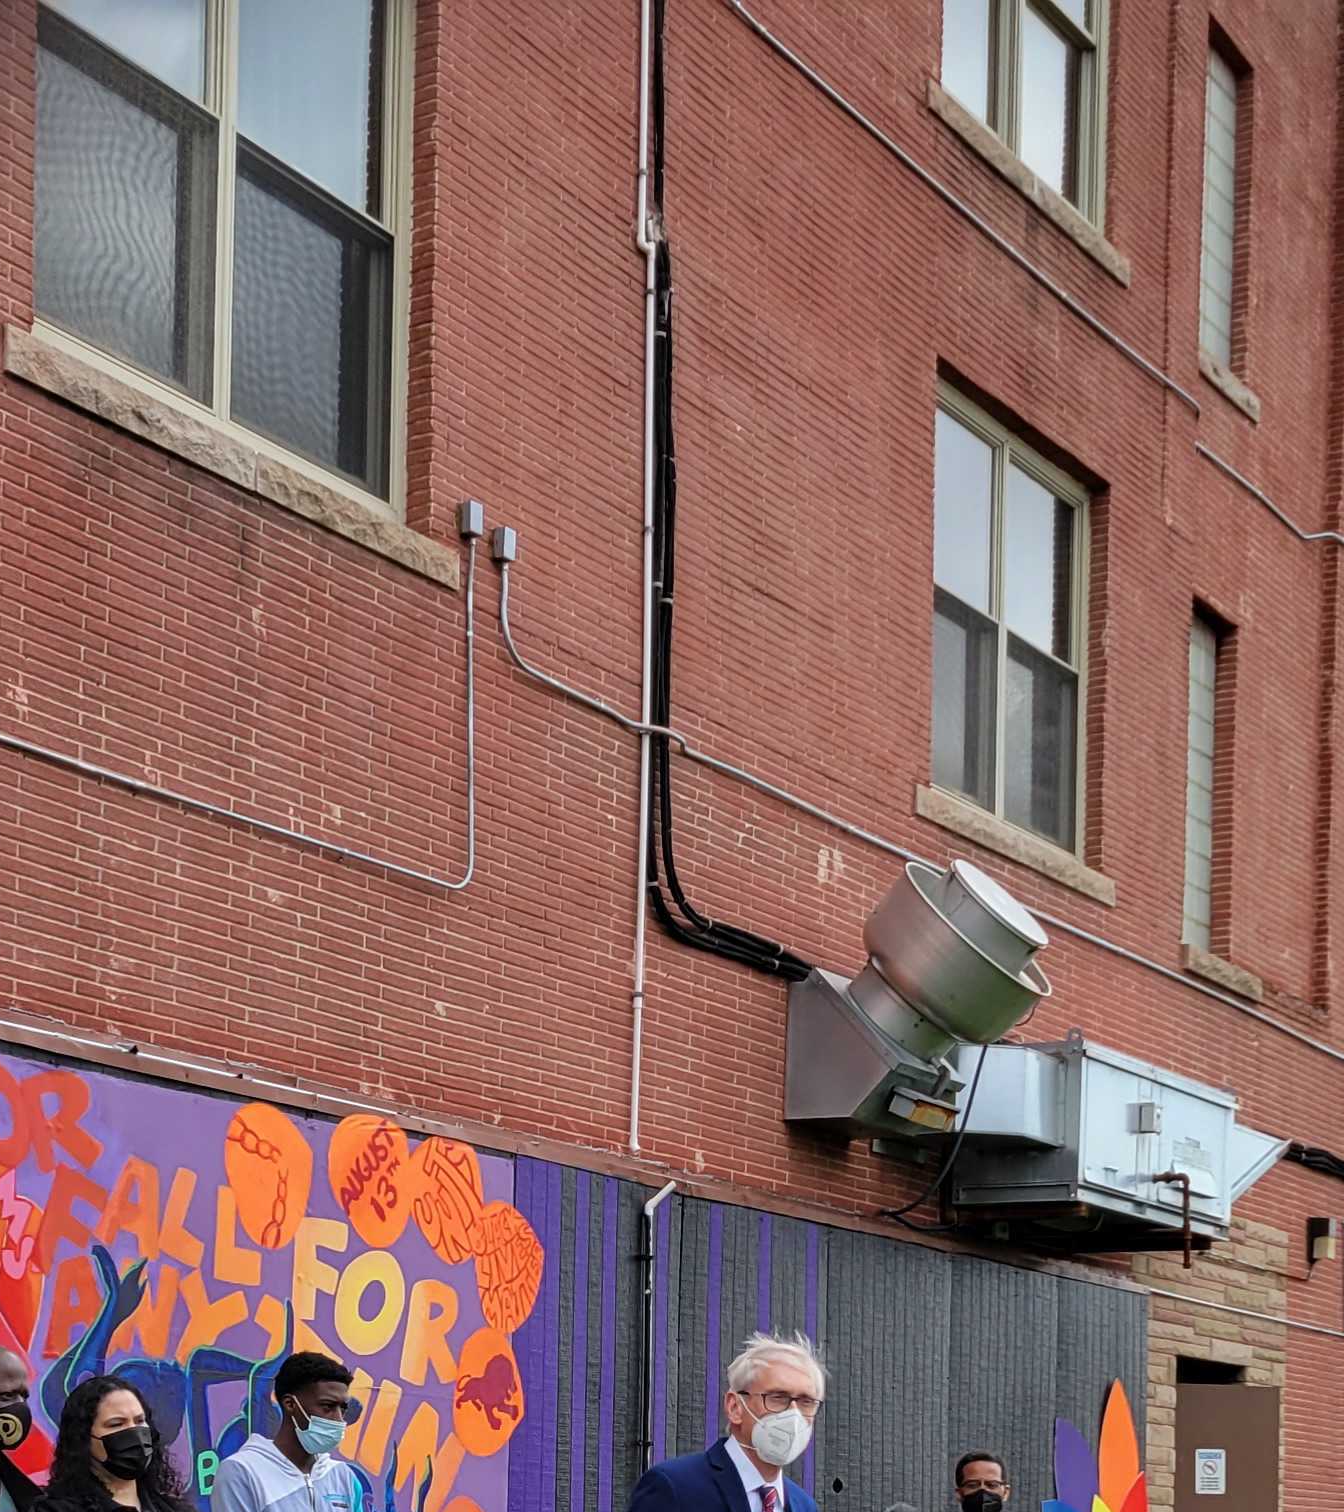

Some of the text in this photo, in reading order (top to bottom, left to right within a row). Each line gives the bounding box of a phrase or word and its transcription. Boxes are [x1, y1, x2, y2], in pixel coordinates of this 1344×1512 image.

[340, 1119, 394, 1217] AUGUST
[36, 1154, 459, 1387] FALL FOR
